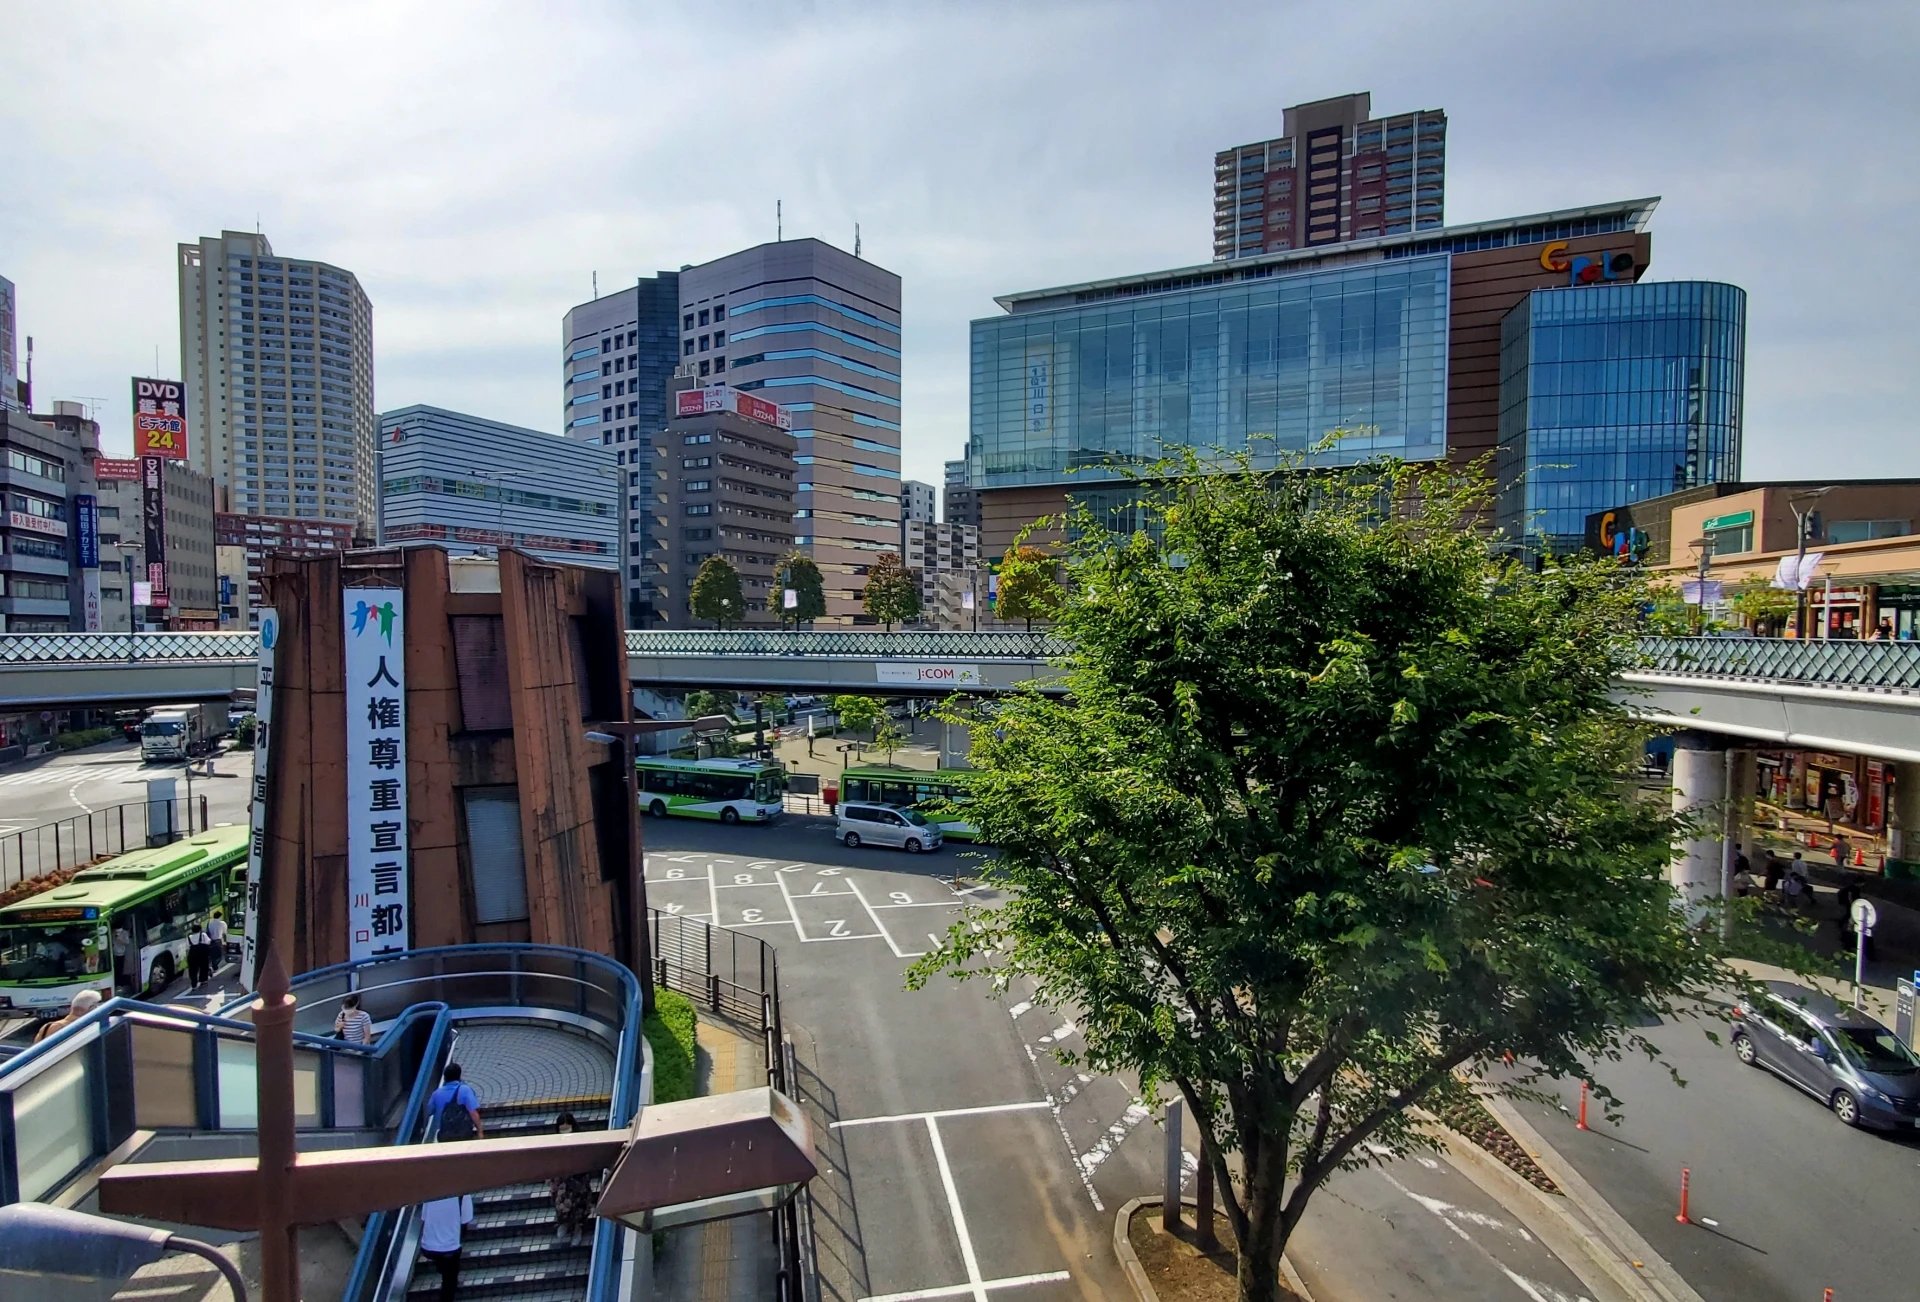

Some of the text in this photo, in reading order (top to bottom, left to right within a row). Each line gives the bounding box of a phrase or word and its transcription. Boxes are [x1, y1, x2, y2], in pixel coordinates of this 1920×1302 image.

[138, 382, 179, 399] DVD
[139, 399, 180, 417] 鑑賞
[139, 417, 180, 432] ビデオ館
[917, 668, 955, 681] J:COM
[733, 873, 753, 885] 8
[810, 881, 829, 894] 7
[354, 893, 369, 944] 川口
[741, 907, 764, 923] 3
[824, 919, 852, 937] 2
